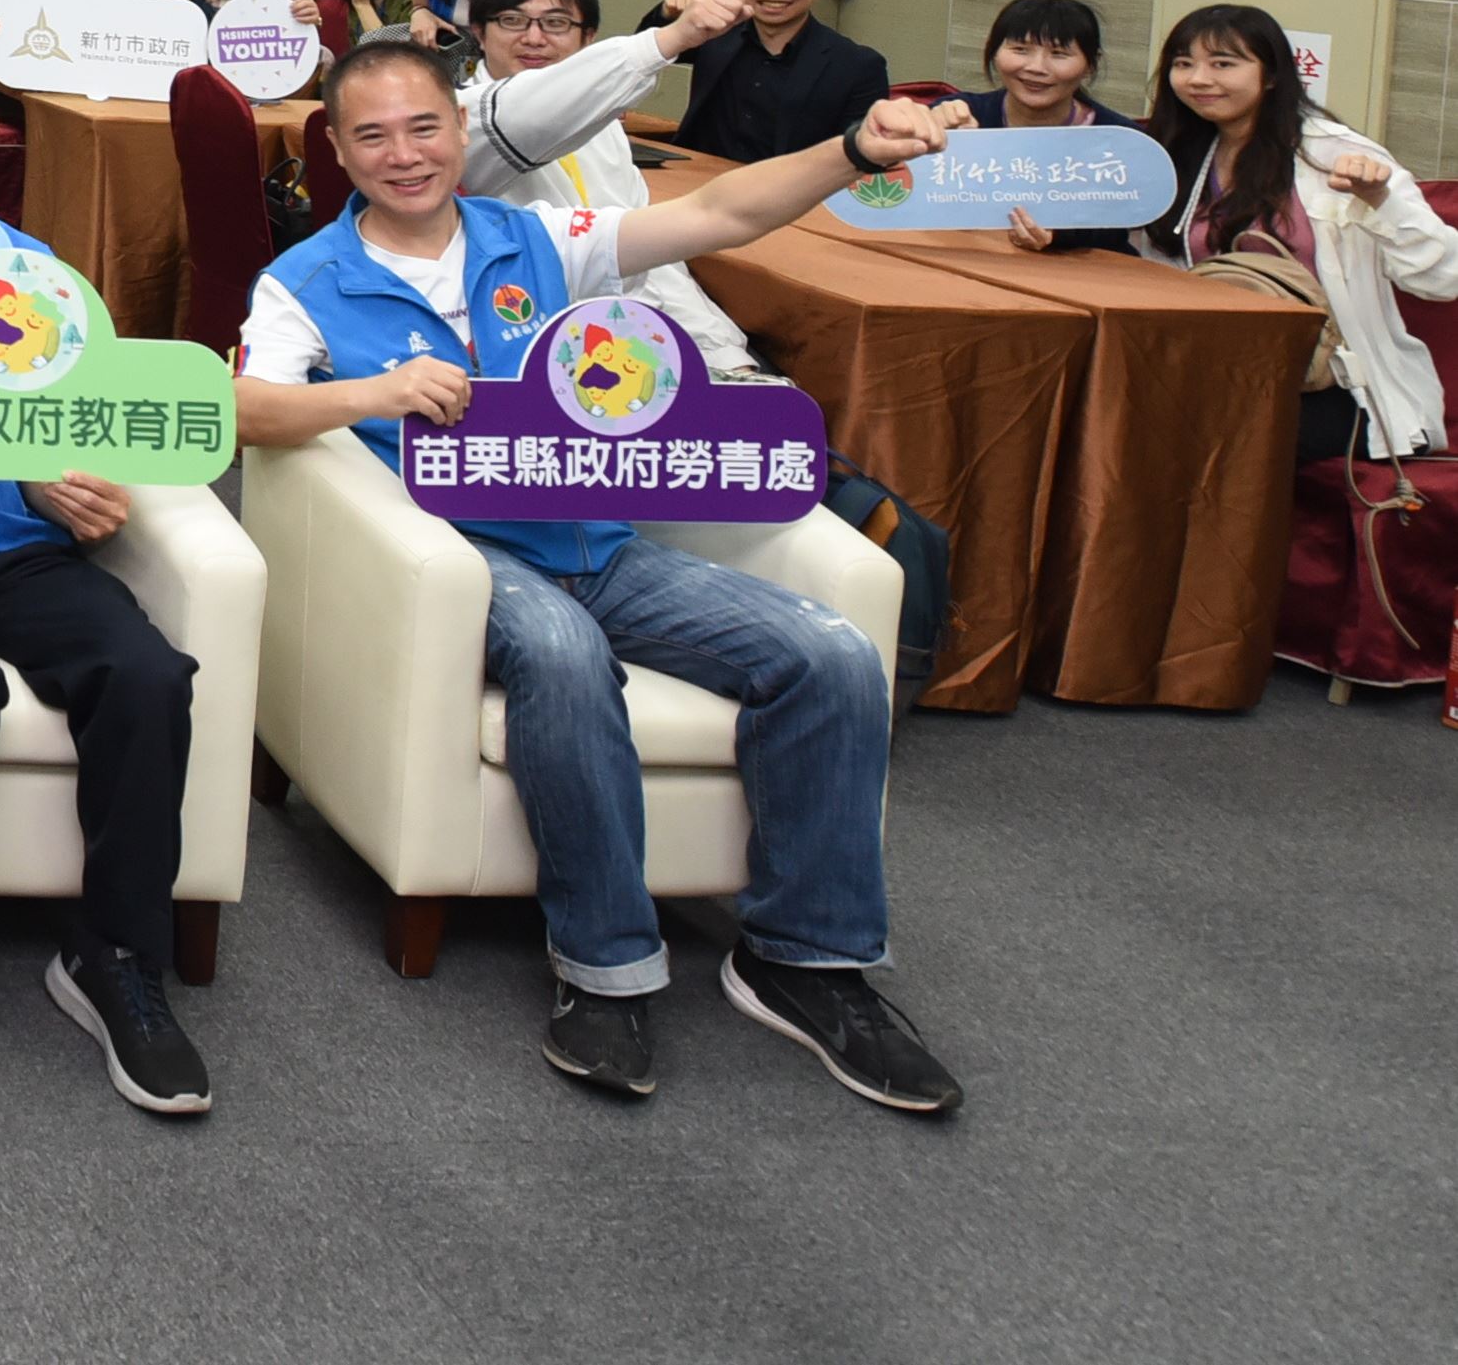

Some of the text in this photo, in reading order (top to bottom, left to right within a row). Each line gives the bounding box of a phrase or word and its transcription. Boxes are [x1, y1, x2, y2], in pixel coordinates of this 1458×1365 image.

[80, 30, 191, 57] 新竹市政府
[221, 28, 276, 41] HSINCHU
[118, 55, 135, 66] City
[221, 40, 303, 61] YOUTH!
[930, 151, 1128, 190] 新竹縣政府
[926, 188, 1140, 204] HsinChu County Government
[411, 434, 817, 492] 苗栗縣政府勞青處
